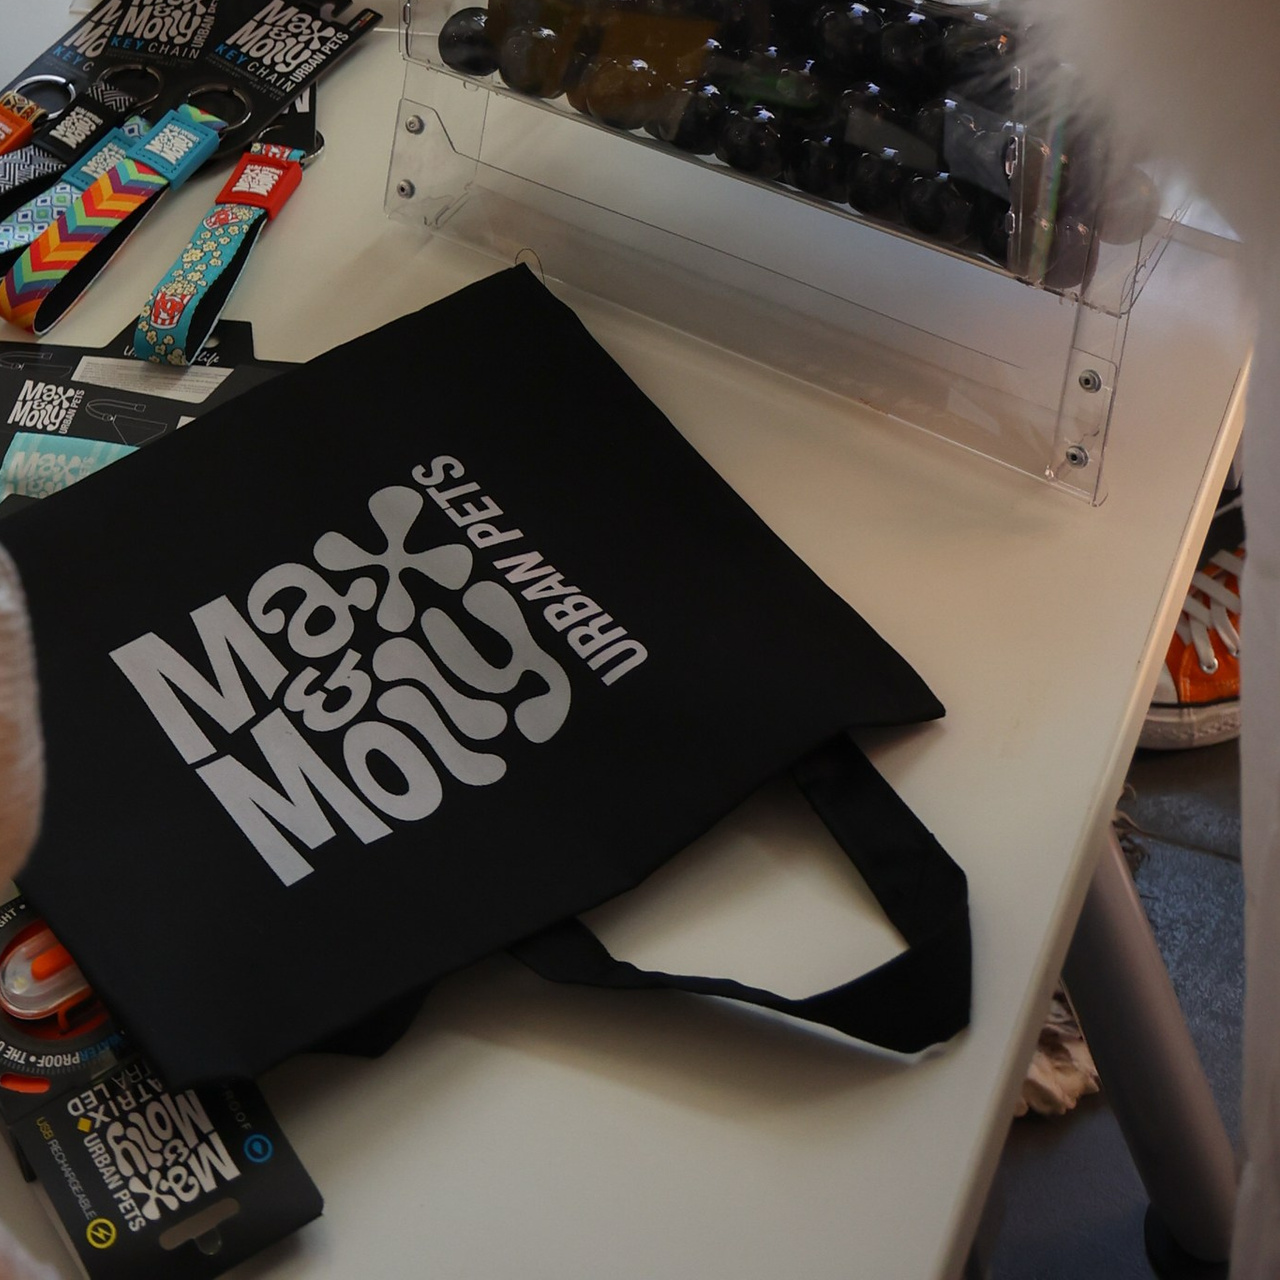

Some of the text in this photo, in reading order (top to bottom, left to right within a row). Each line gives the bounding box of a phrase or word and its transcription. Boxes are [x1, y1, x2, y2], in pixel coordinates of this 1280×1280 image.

[117, 5, 202, 45] Molly
[153, 4, 175, 18] &
[110, 36, 144, 51] KEY
[148, 42, 201, 60] CHAIN
[191, 15, 216, 49] URBAN
[225, 19, 312, 73] Molly
[268, 25, 292, 40] &
[53, 44, 83, 65] KEY
[214, 43, 250, 66] KEY
[247, 61, 296, 93] CHAIN
[289, 53, 326, 84] URBAN
[323, 31, 350, 55] PETS
[49, 111, 84, 140] Max
[62, 116, 97, 150] Molly
[145, 126, 180, 154] Max
[160, 132, 196, 165] Molly
[19, 379, 76, 409] Max
[32, 399, 46, 411] &
[59, 389, 85, 435] URBAN PETS
[7, 400, 68, 432] Molly
[411, 454, 649, 686] URBAN PETS
[109, 485, 474, 766] Max
[282, 648, 372, 732] &
[195, 580, 572, 888] Molly
[3, 1046, 27, 1065] THE
[67, 1082, 111, 1118] LED
[87, 1077, 164, 1129] ATRIX
[106, 1089, 215, 1177] Molly
[35, 1116, 98, 1221] USB RECHARGEABLE
[162, 1138, 190, 1167] &
[83, 1132, 147, 1232] URBAN PETS
[128, 1132, 242, 1221] Max
